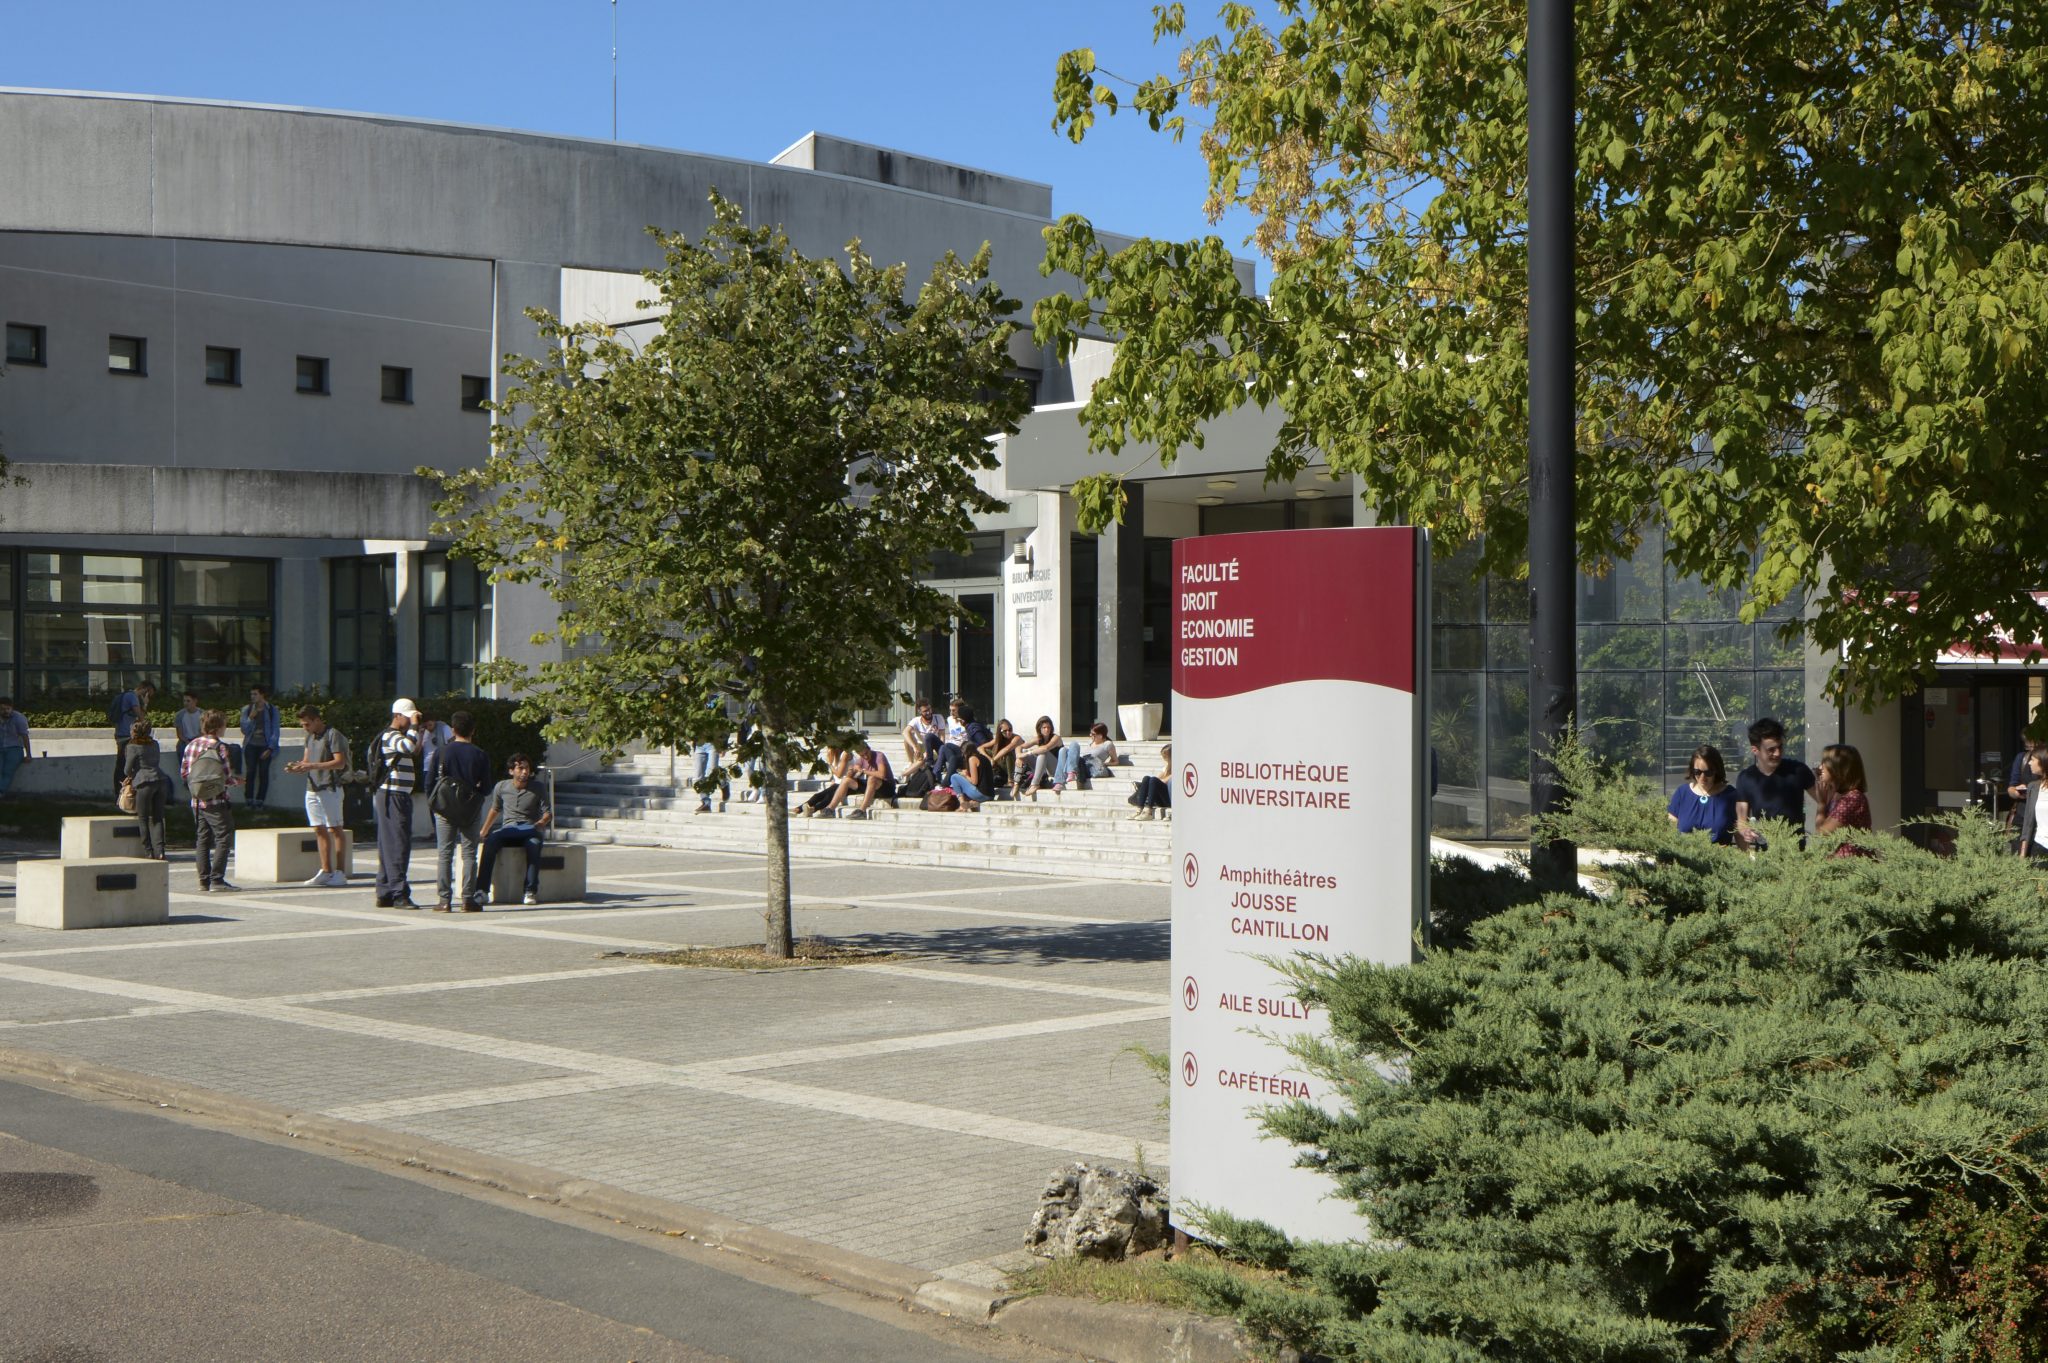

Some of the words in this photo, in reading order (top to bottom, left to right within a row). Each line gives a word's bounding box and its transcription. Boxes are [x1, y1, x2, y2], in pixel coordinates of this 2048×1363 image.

[1181, 558, 1239, 584] FACULTÉ
[1012, 588, 1053, 605] UNIVERSITAIRE
[1181, 591, 1218, 611] DROIT
[1181, 618, 1254, 639] ECONOMIE
[1181, 647, 1238, 667] GESTION
[1220, 760, 1349, 783] BIBLIOTHÈQUE
[1220, 787, 1351, 810] UNIVERSITAIRE
[1219, 864, 1337, 889] Amphithéâtres
[1231, 891, 1297, 913] JOUSSE
[1231, 917, 1329, 942] CANTILLON
[1219, 992, 1252, 1013] AILE
[1257, 998, 1311, 1020] SULLY
[1218, 1069, 1311, 1100] CAFÉTÉRIA
